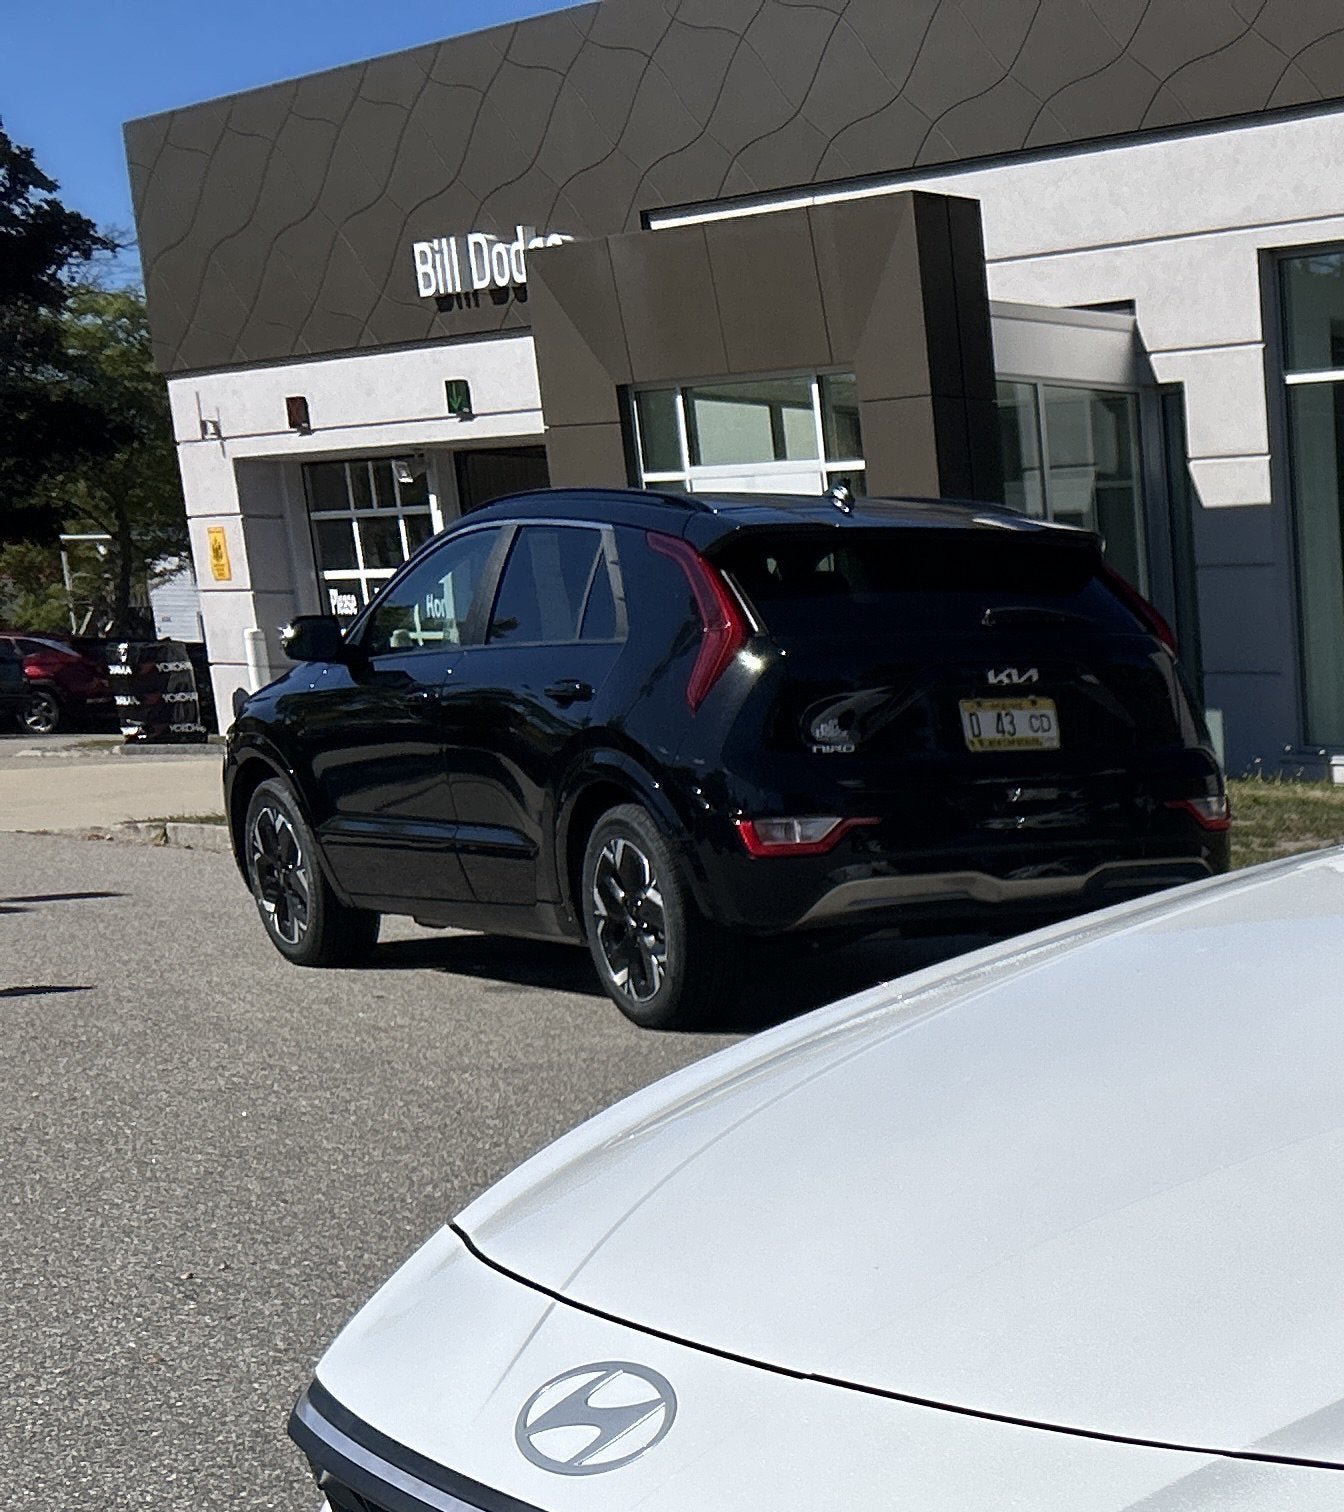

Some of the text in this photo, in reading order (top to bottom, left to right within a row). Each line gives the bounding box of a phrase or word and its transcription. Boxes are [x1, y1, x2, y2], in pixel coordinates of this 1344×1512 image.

[413, 225, 575, 298] Bill Dod
[996, 711, 1017, 737] 43
[1029, 714, 1052, 734] CD
